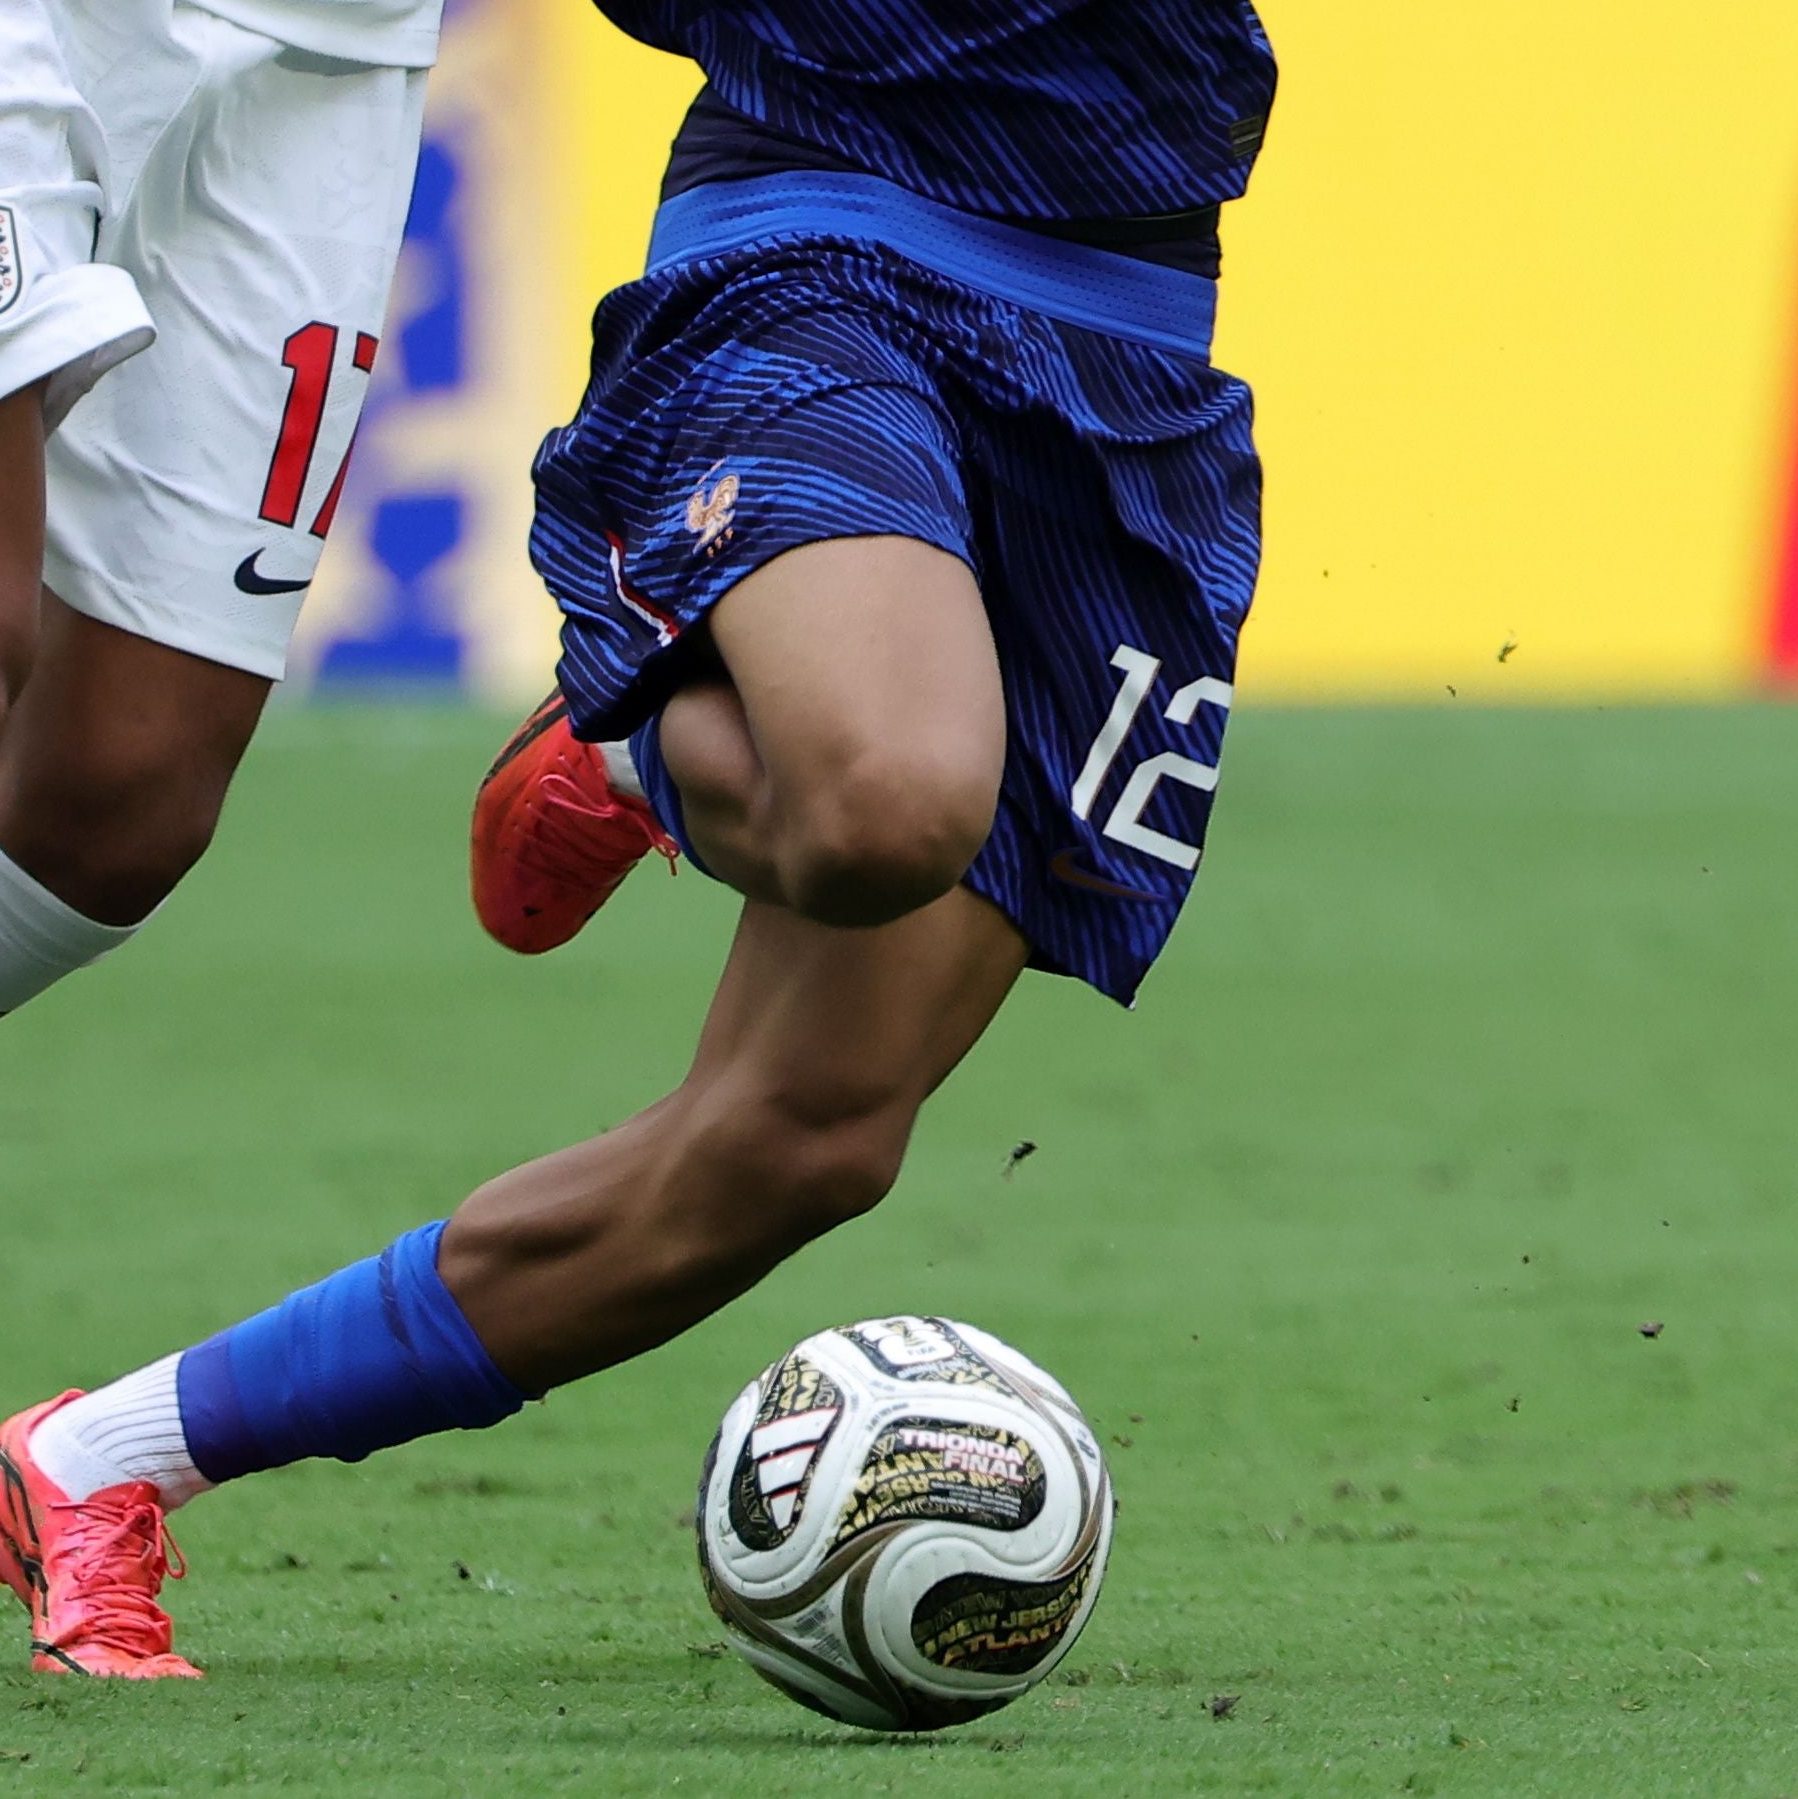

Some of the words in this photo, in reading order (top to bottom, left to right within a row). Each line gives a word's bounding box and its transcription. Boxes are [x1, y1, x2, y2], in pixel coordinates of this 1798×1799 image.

[1071, 643, 1234, 871] 12
[898, 1428, 1024, 1467] TRIONDA
[942, 1451, 1026, 1485] FINAL
